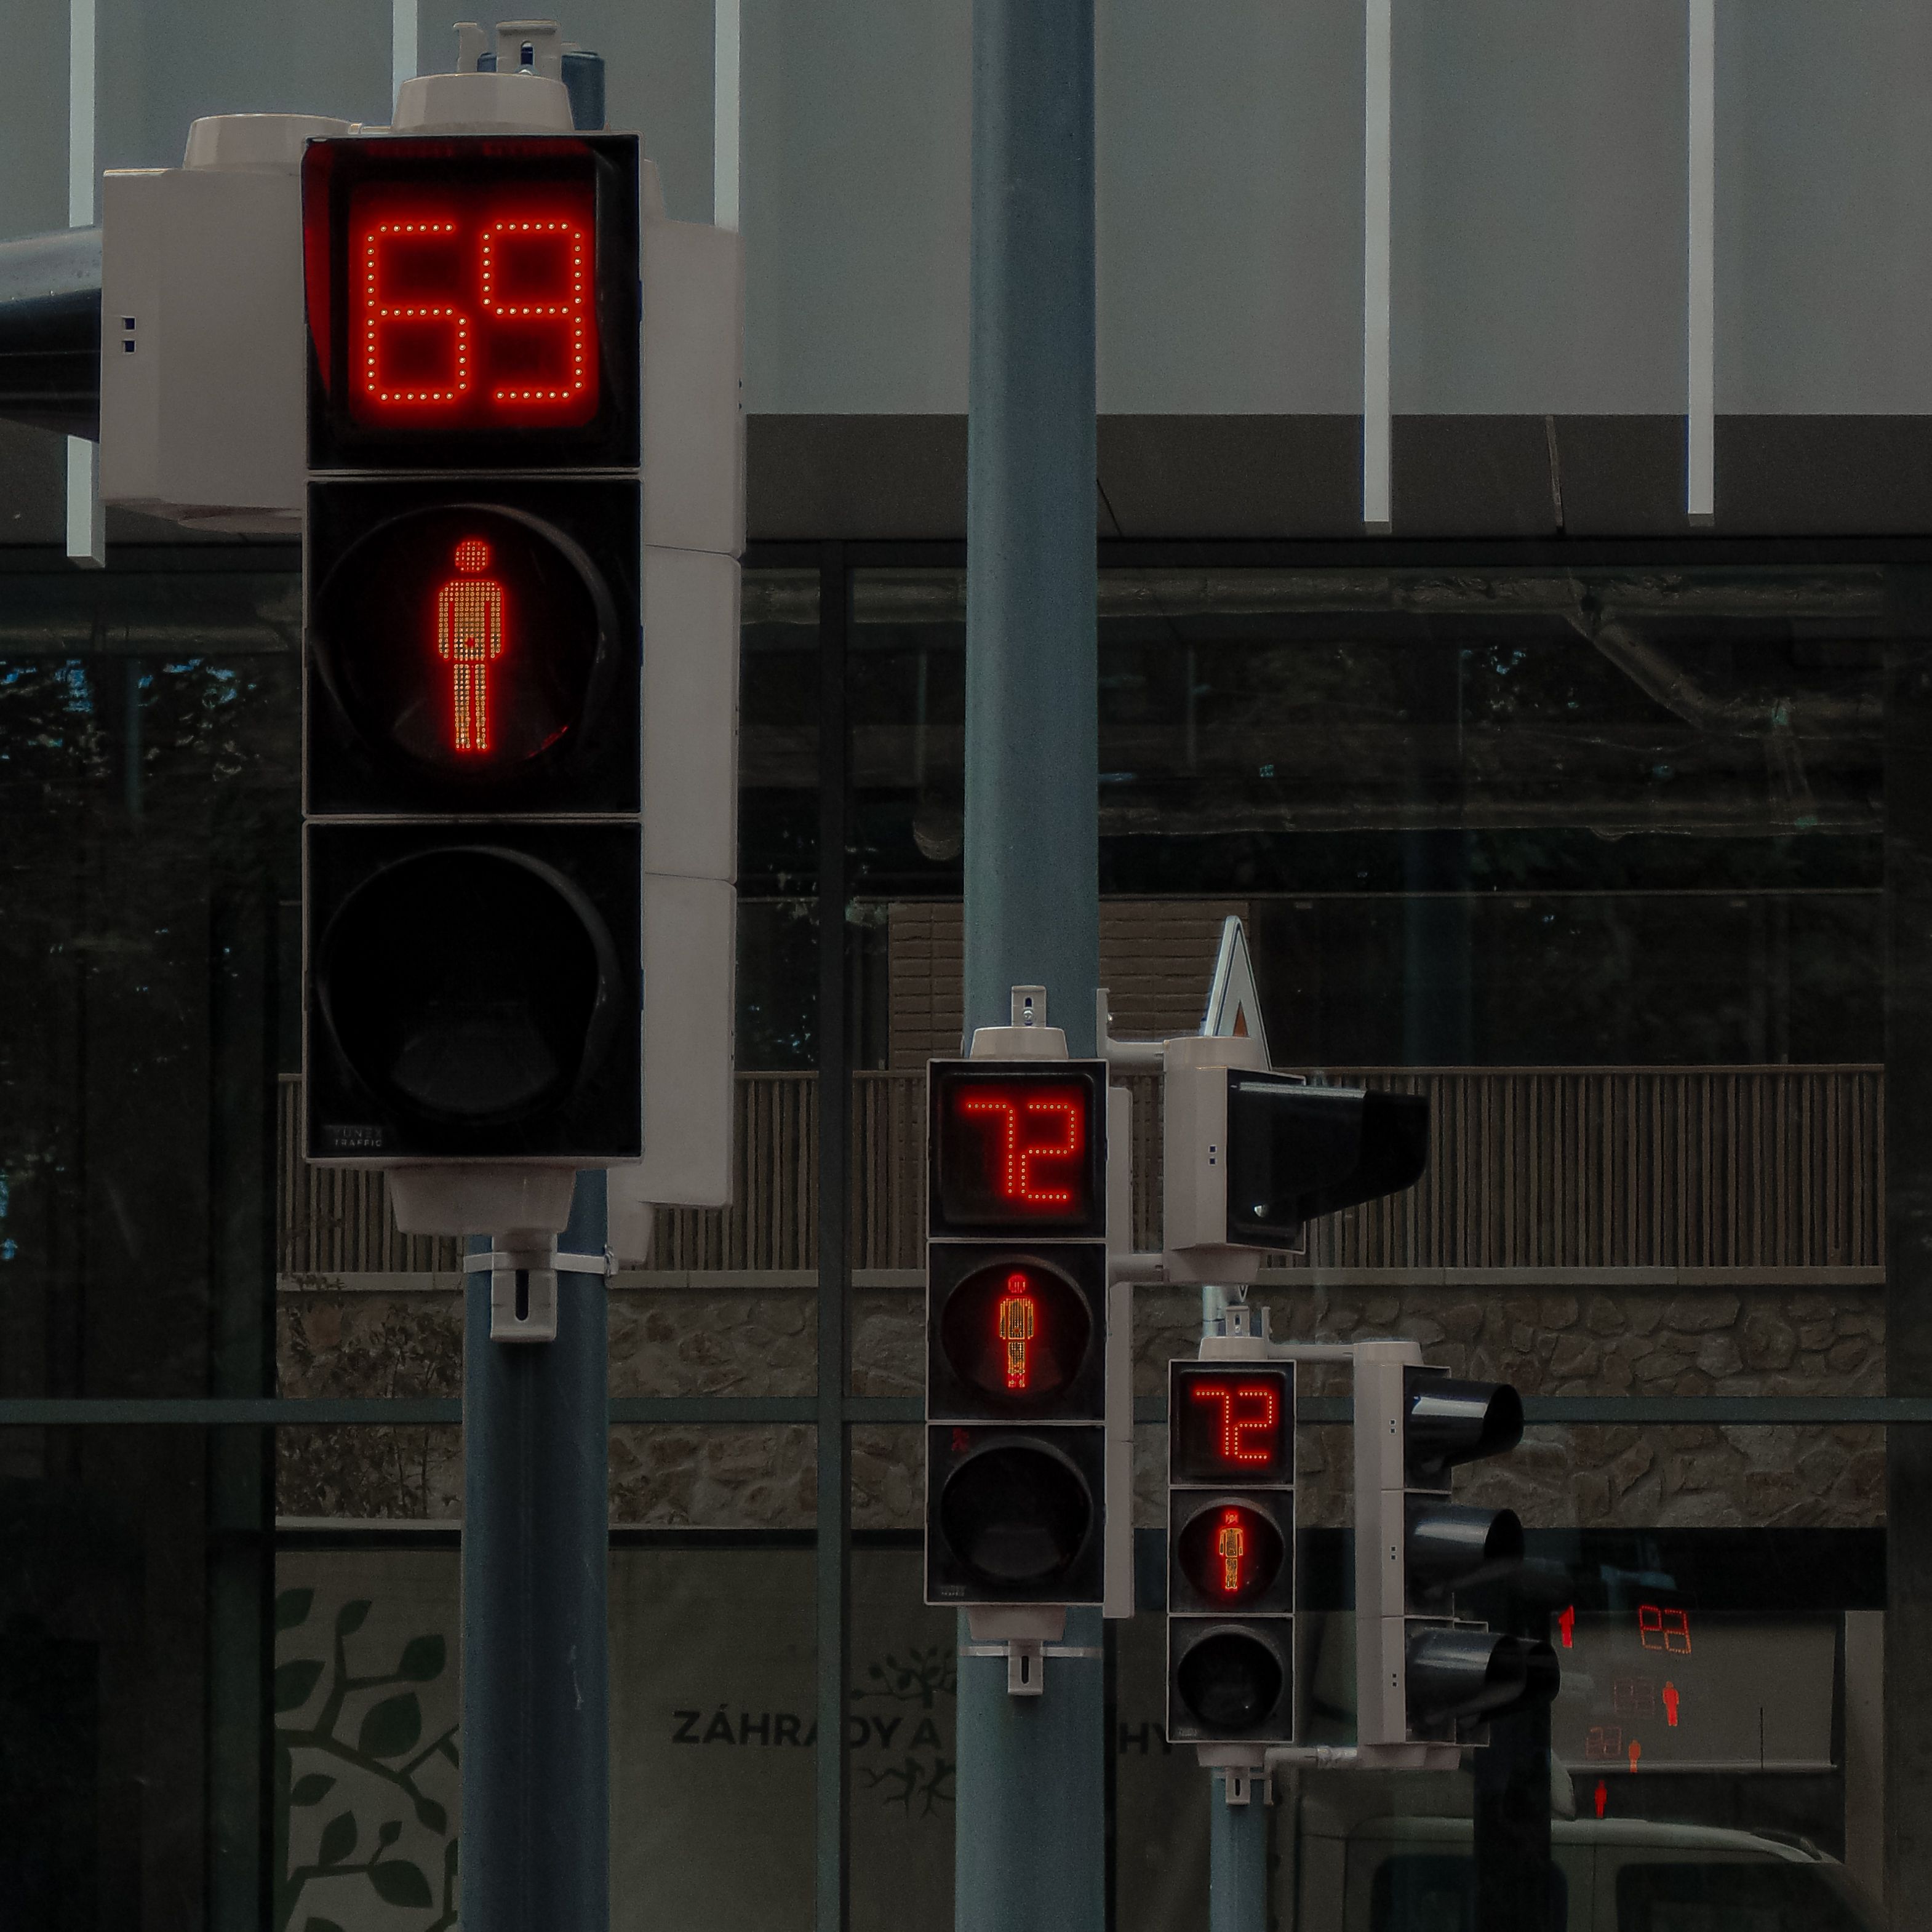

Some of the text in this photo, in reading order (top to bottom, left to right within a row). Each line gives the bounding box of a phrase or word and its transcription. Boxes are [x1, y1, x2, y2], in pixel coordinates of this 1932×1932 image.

[365, 222, 584, 402] 69
[965, 1101, 1079, 1202] 72
[1193, 1389, 1274, 1461] 72
[909, 1717, 942, 1749] A
